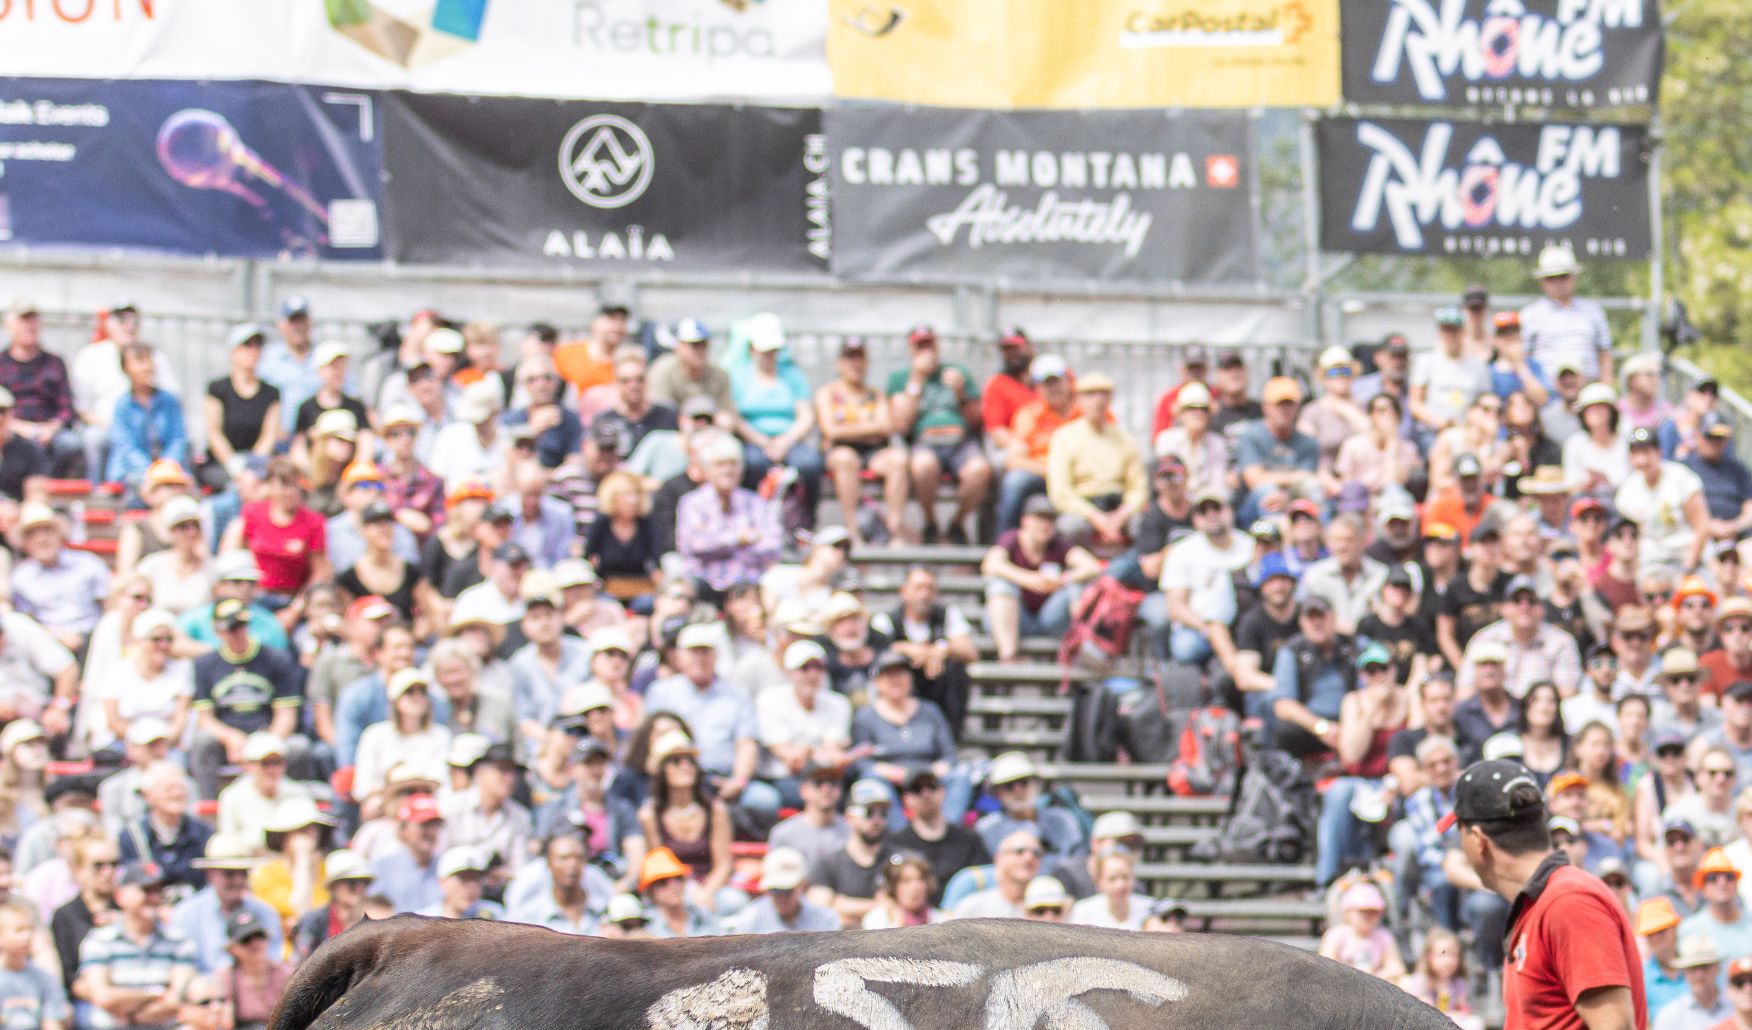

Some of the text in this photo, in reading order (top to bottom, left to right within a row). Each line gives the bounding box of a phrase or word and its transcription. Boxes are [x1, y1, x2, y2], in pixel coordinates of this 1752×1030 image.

[572, 0, 776, 66] Retripa
[1124, 8, 1278, 34] CarPostal
[1371, 0, 1604, 101] Rhône
[841, 147, 1197, 189] CRANS MONTANA
[1351, 121, 1620, 249] Rhône FM
[543, 224, 675, 261] ALAÏA
[927, 183, 1152, 258] Absolutely
